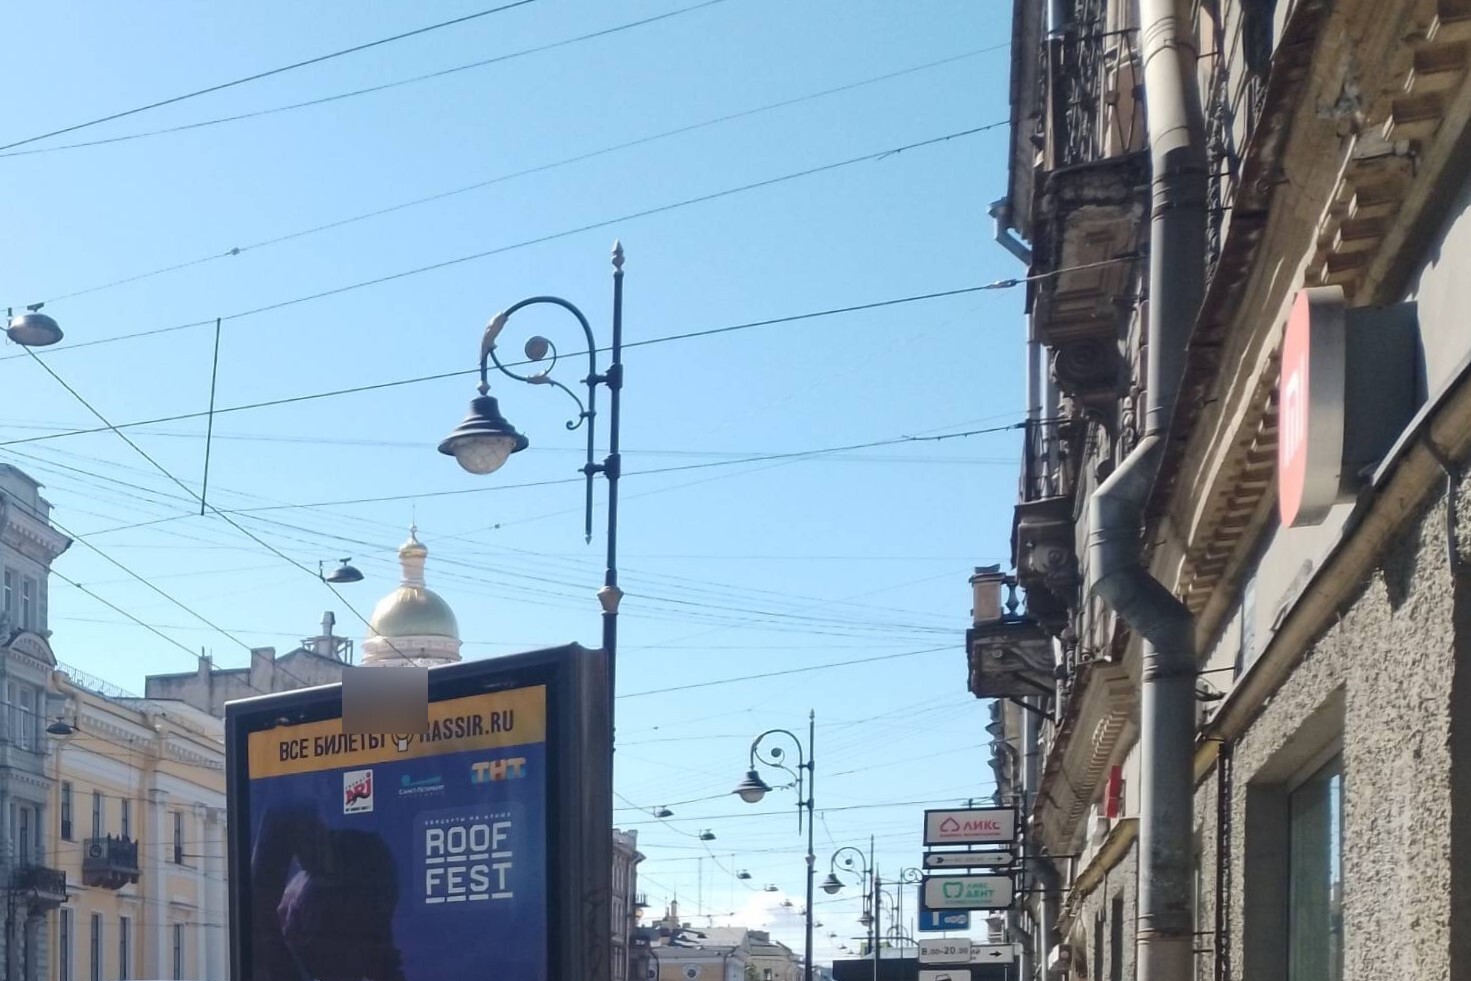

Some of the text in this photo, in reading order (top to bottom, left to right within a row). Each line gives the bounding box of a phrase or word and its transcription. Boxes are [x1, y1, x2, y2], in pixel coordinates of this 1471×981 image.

[280, 738, 309, 762] ВСЕ
[314, 733, 385, 757] БИЛЕТЫ
[426, 821, 512, 855] ROOF
[963, 820, 1001, 831] ЛИКС
[426, 863, 513, 895] FEST
